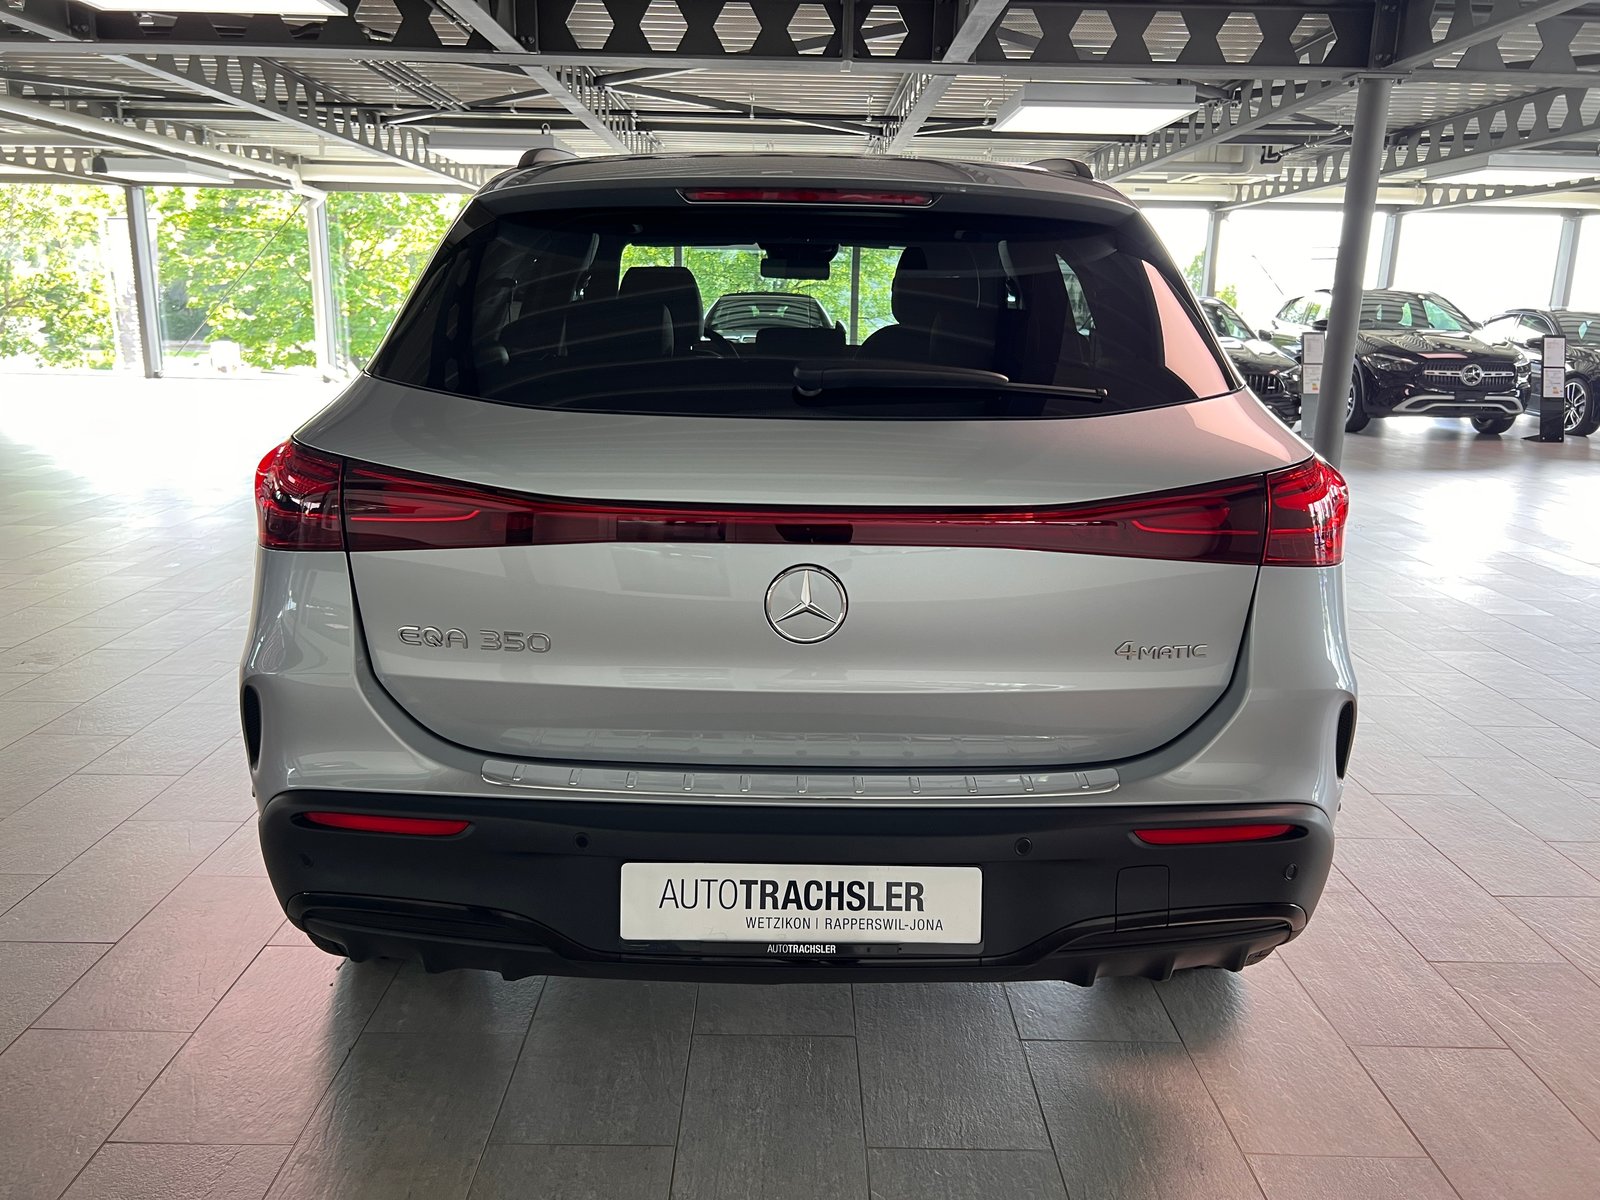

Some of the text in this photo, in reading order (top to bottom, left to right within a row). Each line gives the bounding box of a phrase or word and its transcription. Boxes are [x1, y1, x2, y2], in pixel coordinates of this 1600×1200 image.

[397, 624, 552, 654] EQA 350
[659, 878, 925, 912] AUTOTRACHSLER
[745, 917, 811, 930] WETZIKON
[824, 918, 944, 931] RAPPERSWIL-JONA
[766, 944, 837, 954] AUTOTRACHSLER
